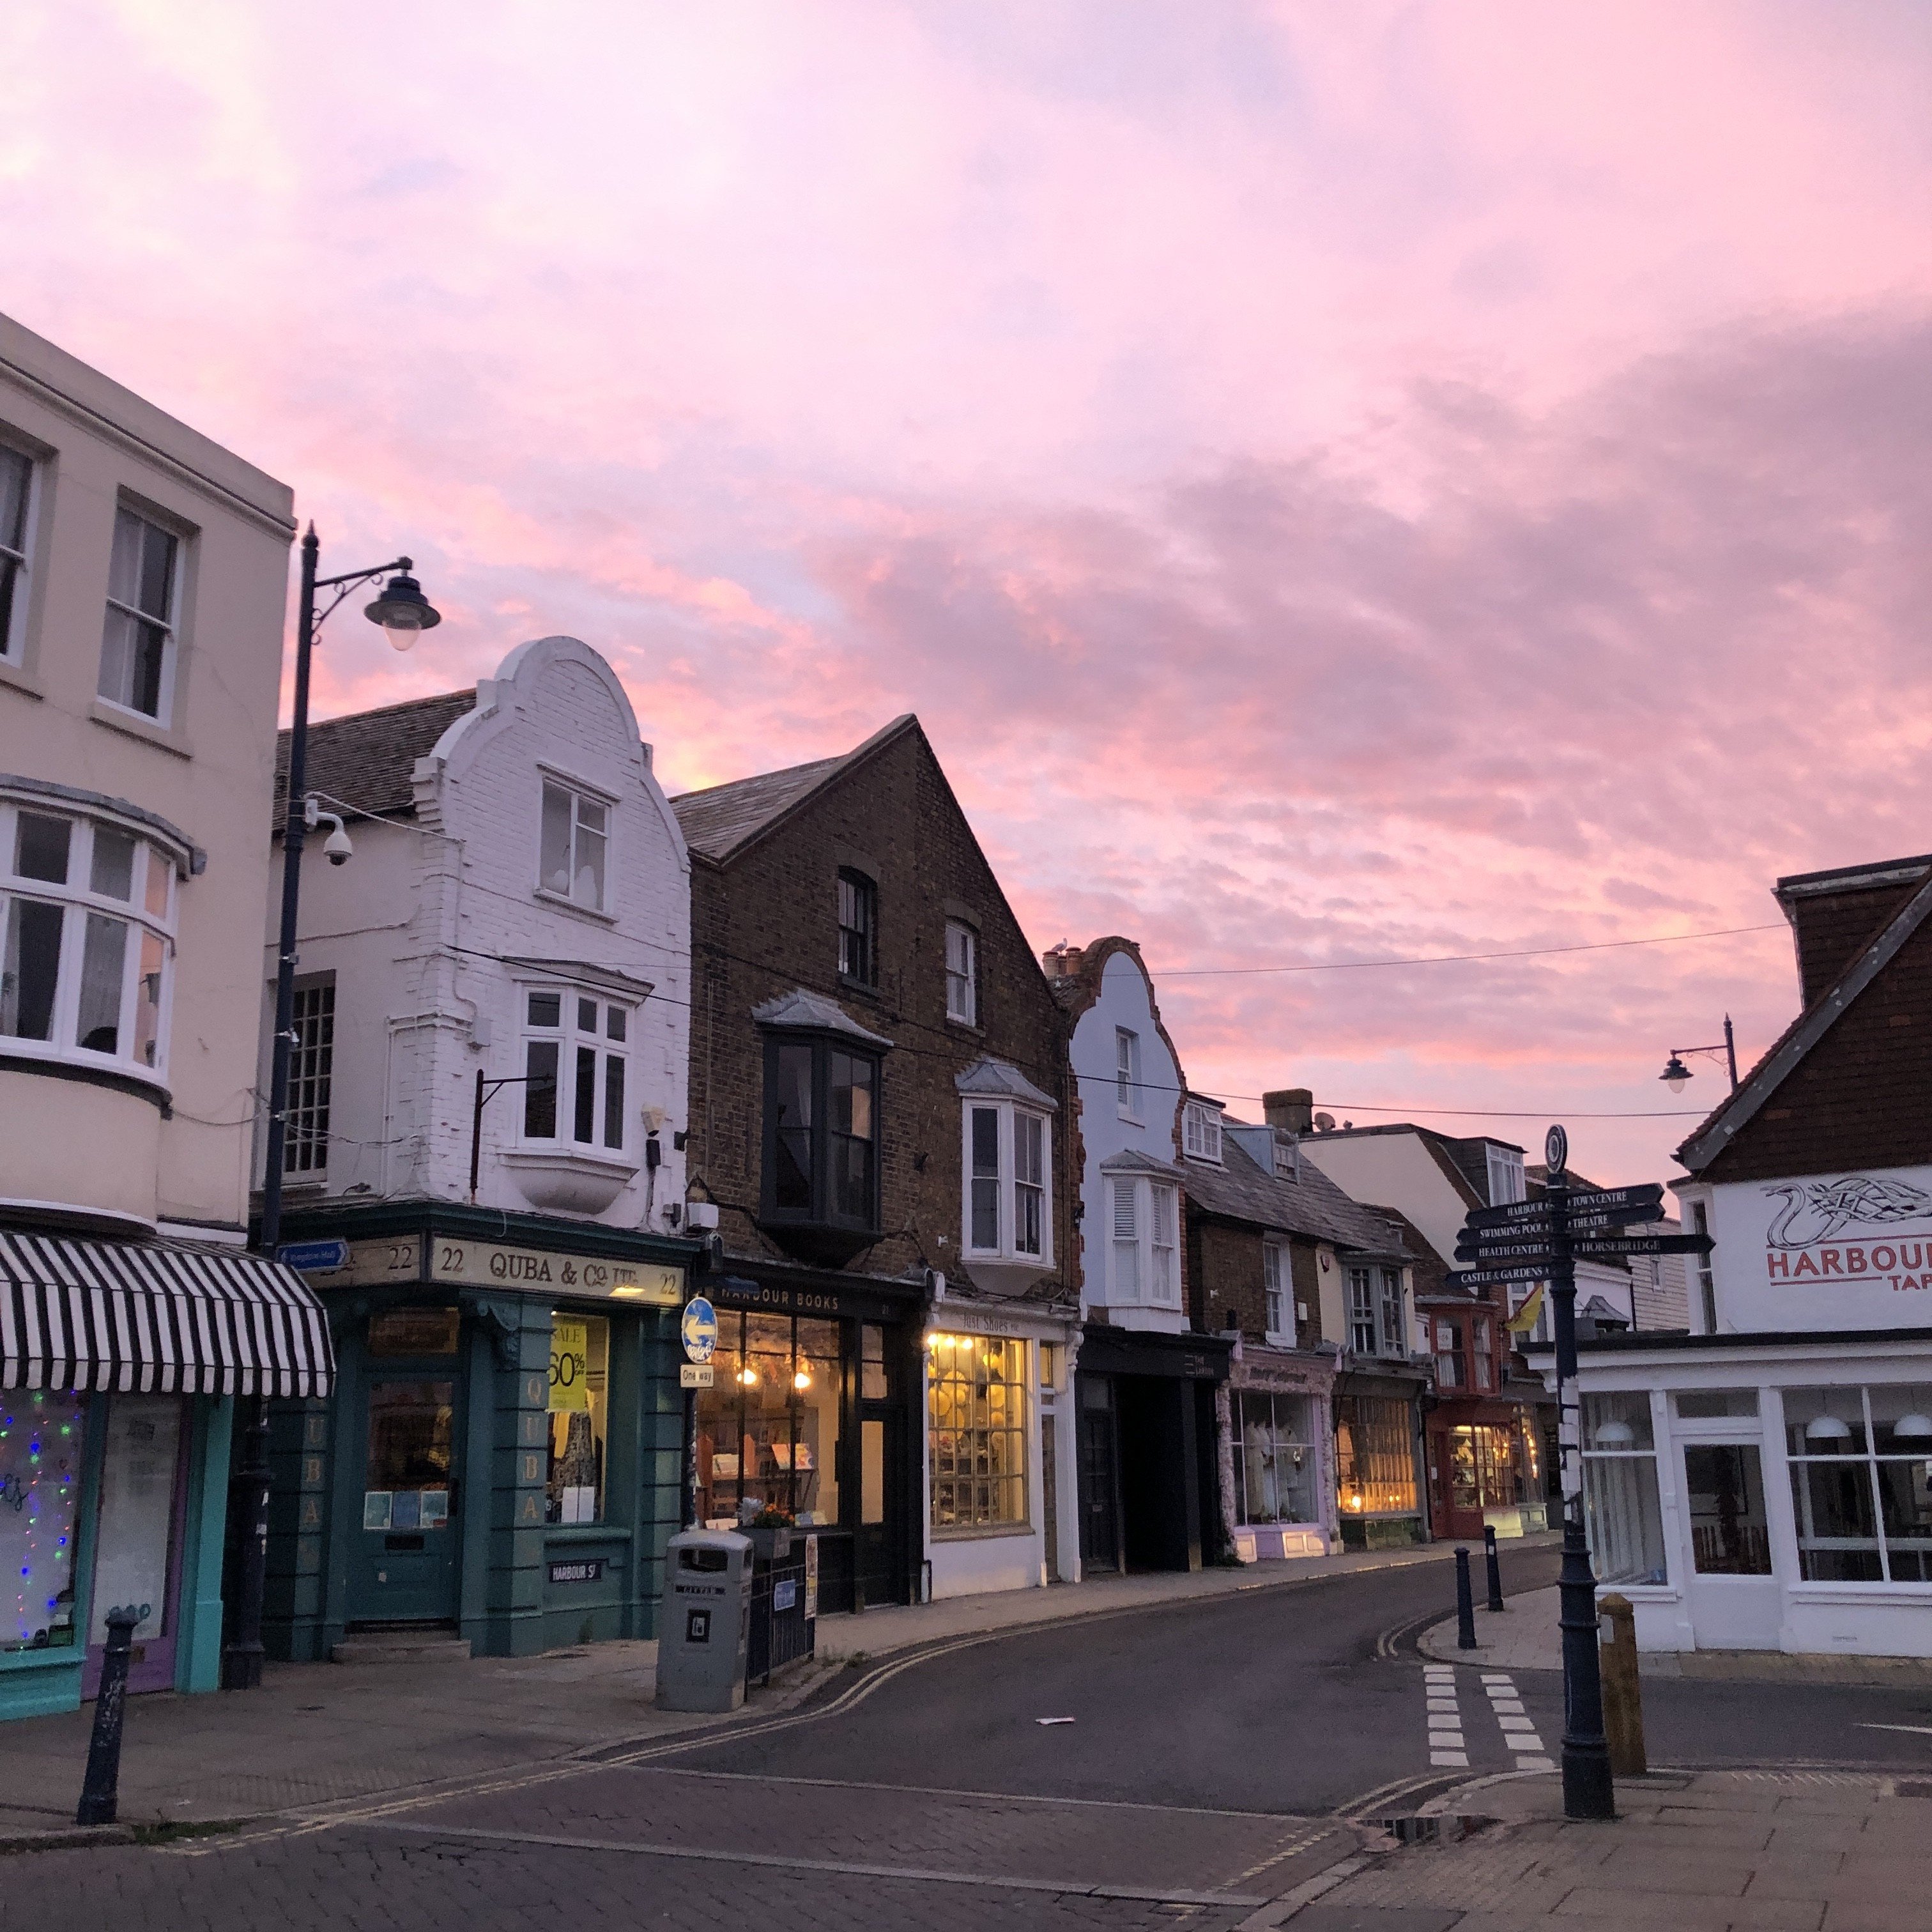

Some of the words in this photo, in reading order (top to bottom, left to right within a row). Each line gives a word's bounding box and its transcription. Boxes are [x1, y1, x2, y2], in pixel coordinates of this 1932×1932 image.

[1573, 1195, 1595, 1207] TOWN
[1597, 1191, 1627, 1204] CENTRE
[1507, 1202, 1543, 1216] HARBOUR
[1573, 1214, 1608, 1229] THEATRE
[1480, 1225, 1521, 1239] SWIMMING
[1522, 1223, 1543, 1234] POOL
[1478, 1246, 1510, 1257] HEALTH
[1511, 1243, 1544, 1255] CENTRE
[1582, 1240, 1660, 1252] HORSEBRIDGE
[388, 1246, 412, 1270] 22
[1767, 1243, 1932, 1278] HARBOU
[441, 1247, 463, 1273] 22
[489, 1252, 553, 1283] QUBA
[561, 1261, 578, 1285] &
[659, 1273, 676, 1294] 22
[1460, 1271, 1492, 1284] CASTLE
[1501, 1266, 1543, 1280] GARDENS
[797, 1293, 838, 1310] BOOKS
[984, 1315, 1008, 1333] Shoes
[683, 1370, 696, 1381] One
[699, 1372, 711, 1382] way
[553, 1565, 586, 1581] HARBOUR
